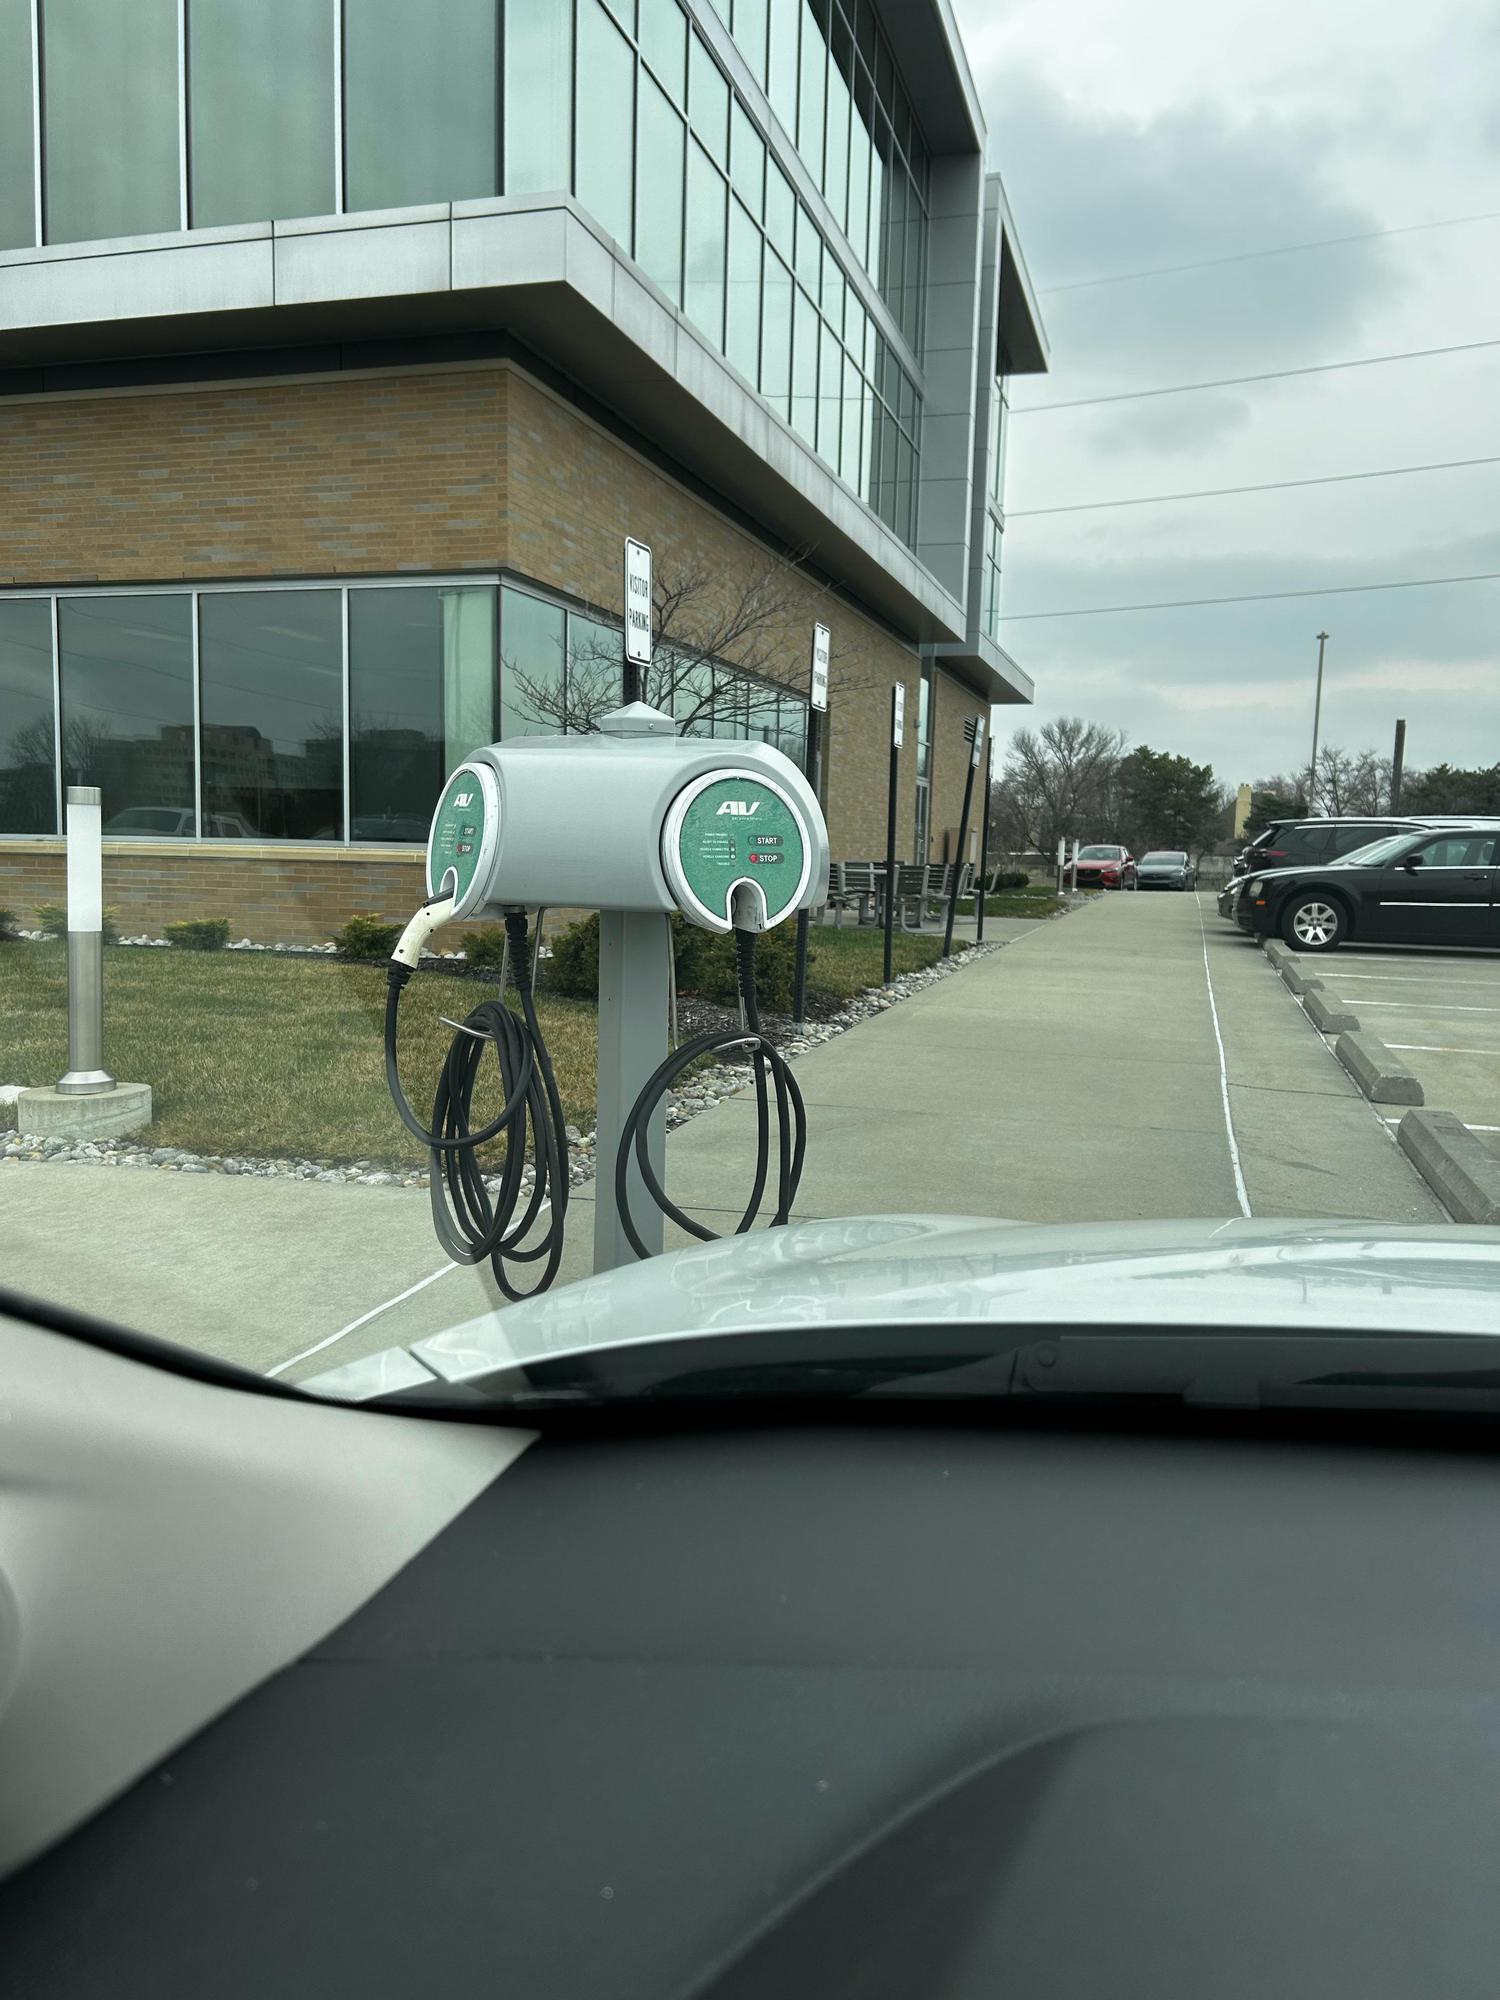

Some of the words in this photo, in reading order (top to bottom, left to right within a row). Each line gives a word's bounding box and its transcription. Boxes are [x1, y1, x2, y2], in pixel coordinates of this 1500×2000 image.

[629, 573, 648, 598] VISITOR
[629, 608, 648, 632] PARKING
[453, 793, 474, 807] AV
[716, 801, 760, 815] AV
[757, 837, 777, 845] START
[759, 854, 778, 862] STOP
